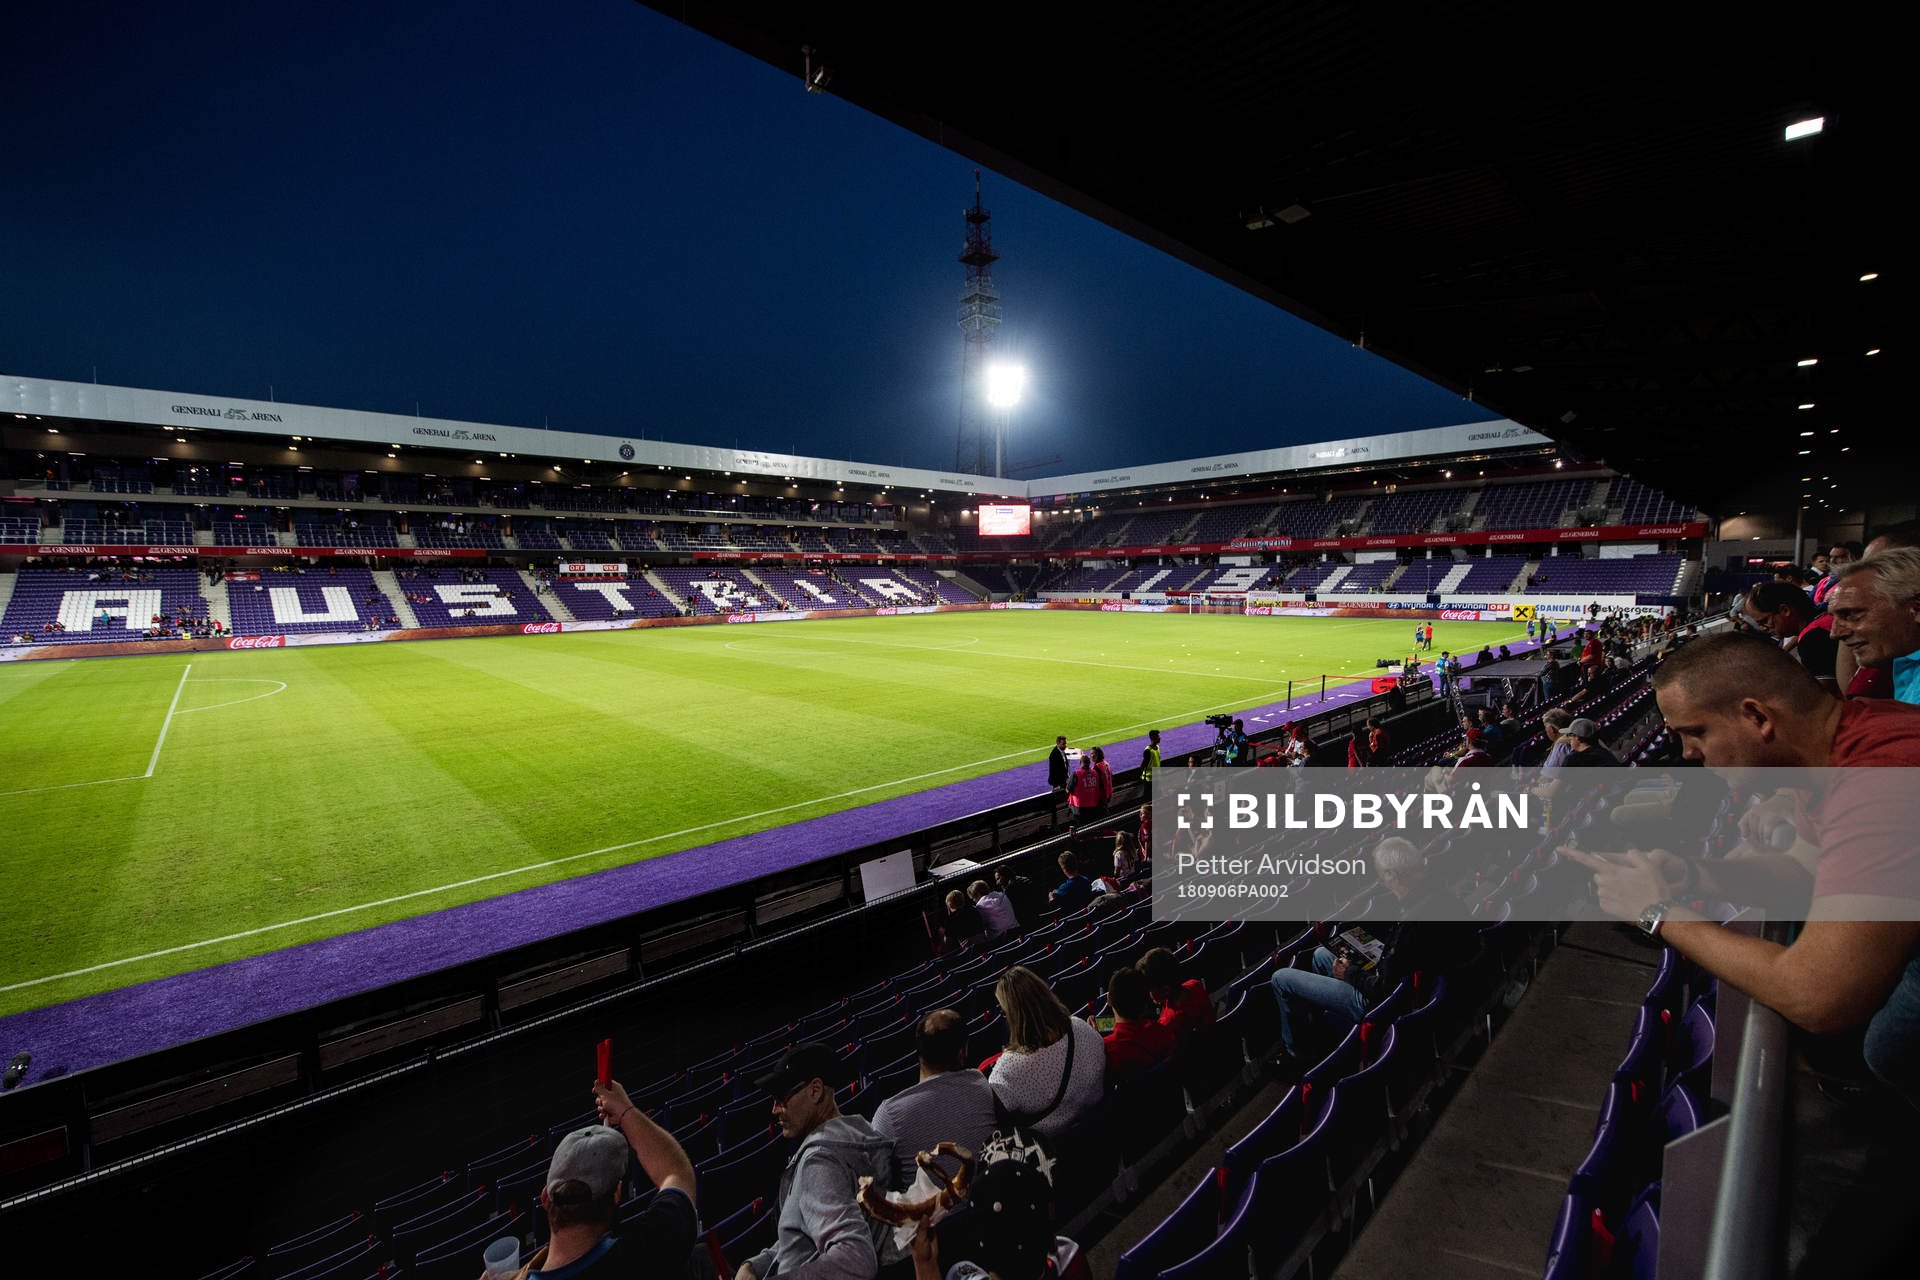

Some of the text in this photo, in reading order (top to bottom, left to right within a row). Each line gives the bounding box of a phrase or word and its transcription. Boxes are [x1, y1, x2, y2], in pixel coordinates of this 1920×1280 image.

[171, 405, 283, 422] GENERALI ARENA
[413, 427, 496, 441] GENERALI ARENA
[1468, 431, 1501, 441] GENERALI
[1651, 527, 1682, 535] GENERALI
[52, 546, 96, 554] GENERALI
[160, 547, 199, 555] GENERALI
[1451, 603, 1488, 611] HYUNDAI
[1489, 603, 1509, 612] ORF
